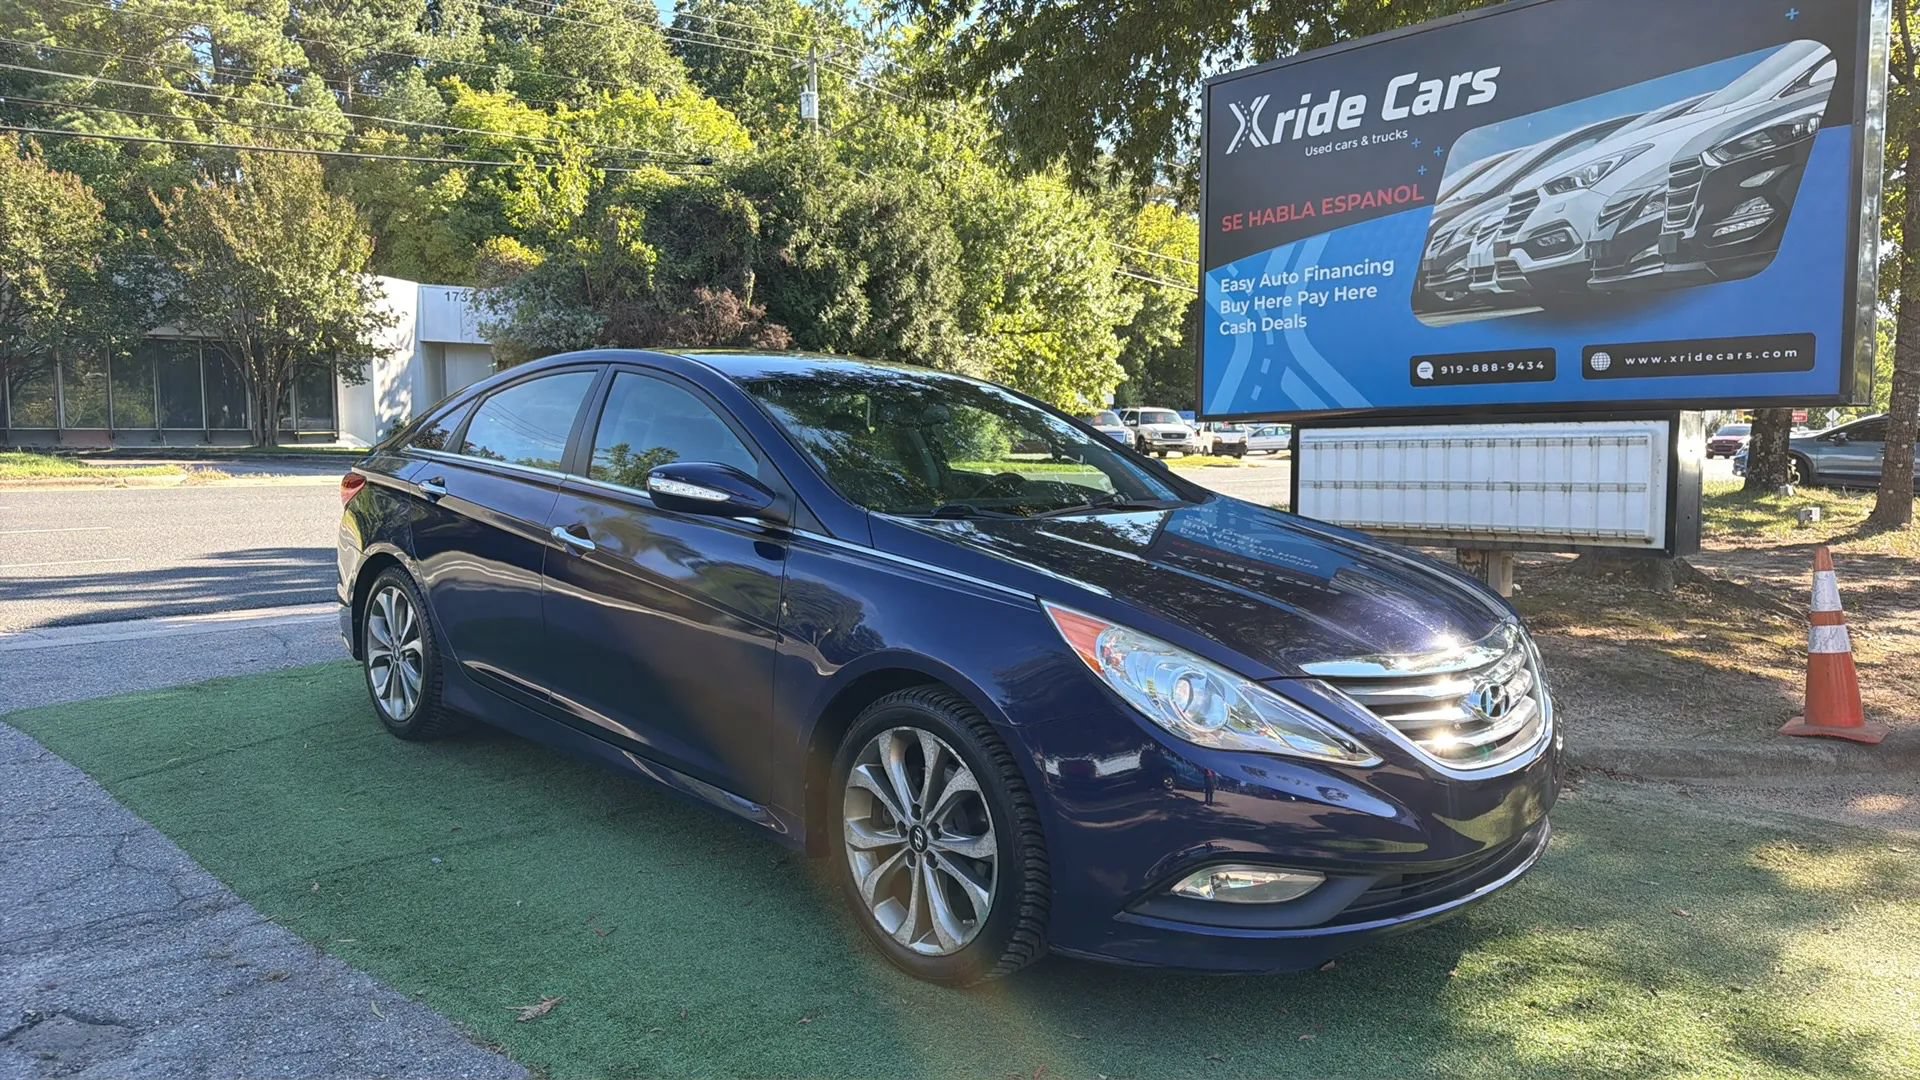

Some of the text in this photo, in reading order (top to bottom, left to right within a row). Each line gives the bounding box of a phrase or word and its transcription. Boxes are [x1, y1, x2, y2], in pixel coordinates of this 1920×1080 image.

[1226, 66, 1501, 155] Xride Cars
[1305, 128, 1409, 157] Used cars & trucks
[1221, 184, 1425, 232] SE HABLA ESPANOL
[1220, 258, 1395, 293] Easy Auto Financing
[1220, 285, 1378, 316] Buy Here Pay Here
[1219, 314, 1307, 336] Cash Deals
[1440, 361, 1545, 374] 919-888-9434
[1624, 350, 1798, 365] www.xridecars.com
